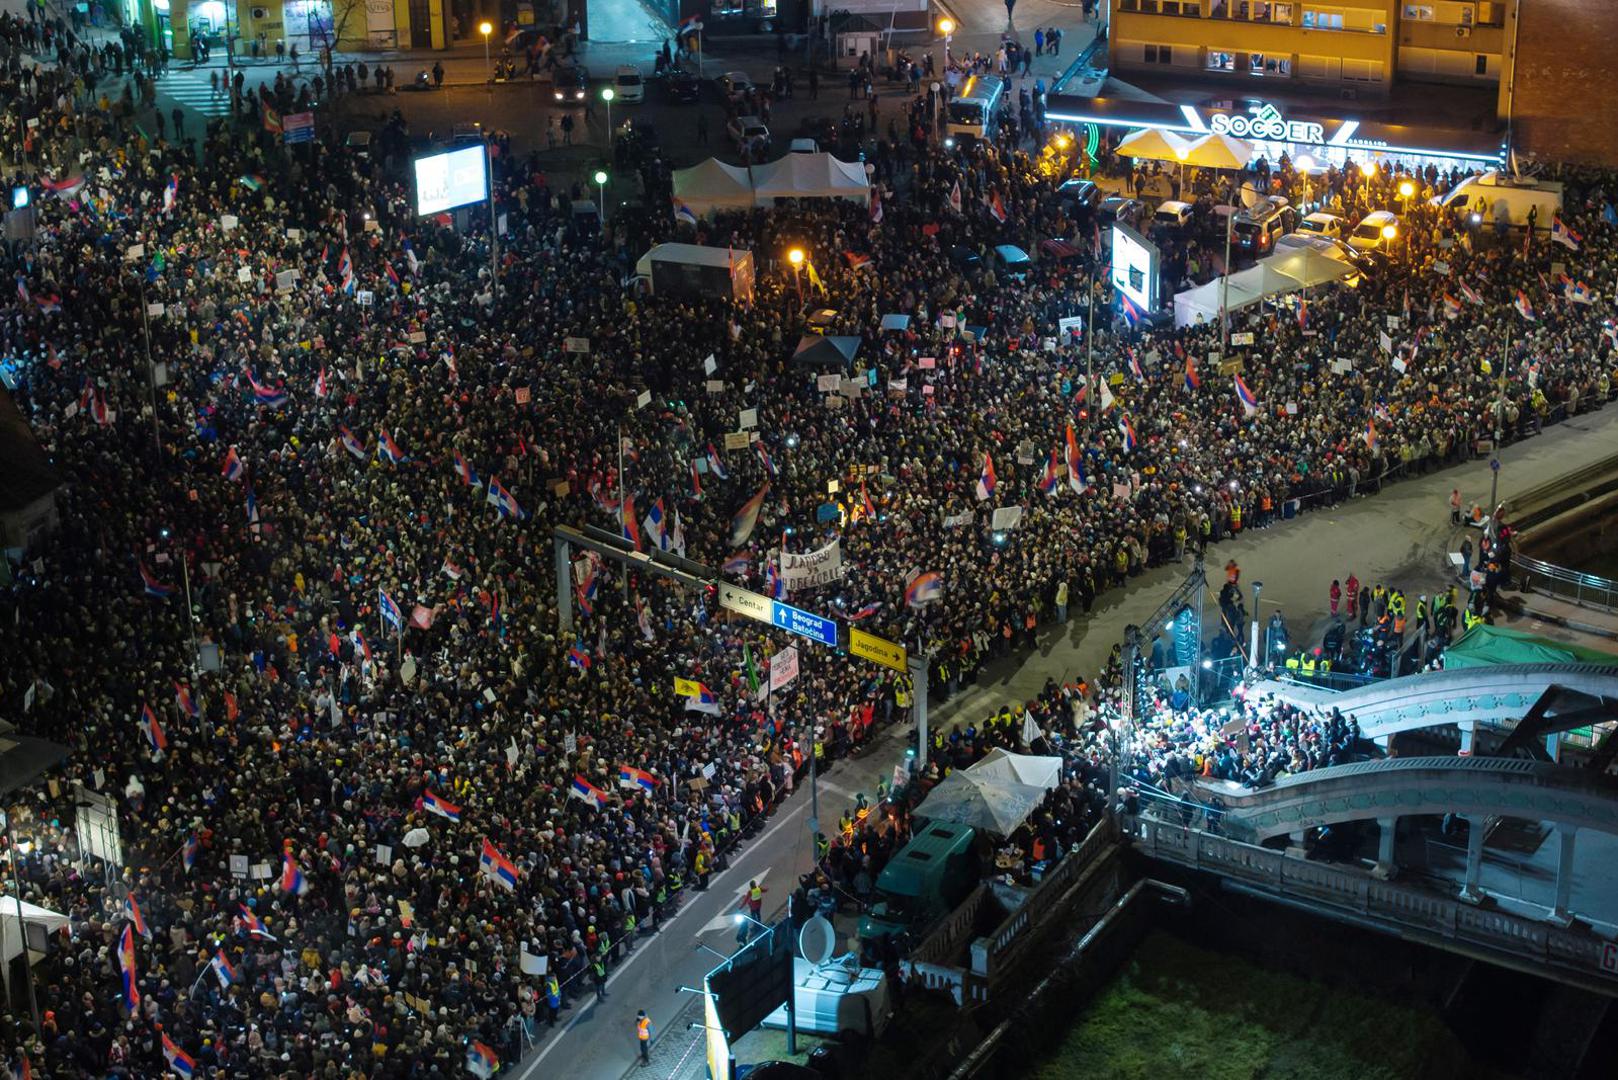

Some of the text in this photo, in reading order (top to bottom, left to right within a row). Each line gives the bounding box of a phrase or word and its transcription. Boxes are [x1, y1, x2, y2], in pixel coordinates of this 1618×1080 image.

[1211, 113, 1325, 144] SOCCER
[738, 596, 764, 613] Centar
[792, 611, 823, 629] Beograd
[792, 622, 825, 640] Batočina
[856, 639, 889, 658] Jagodina
